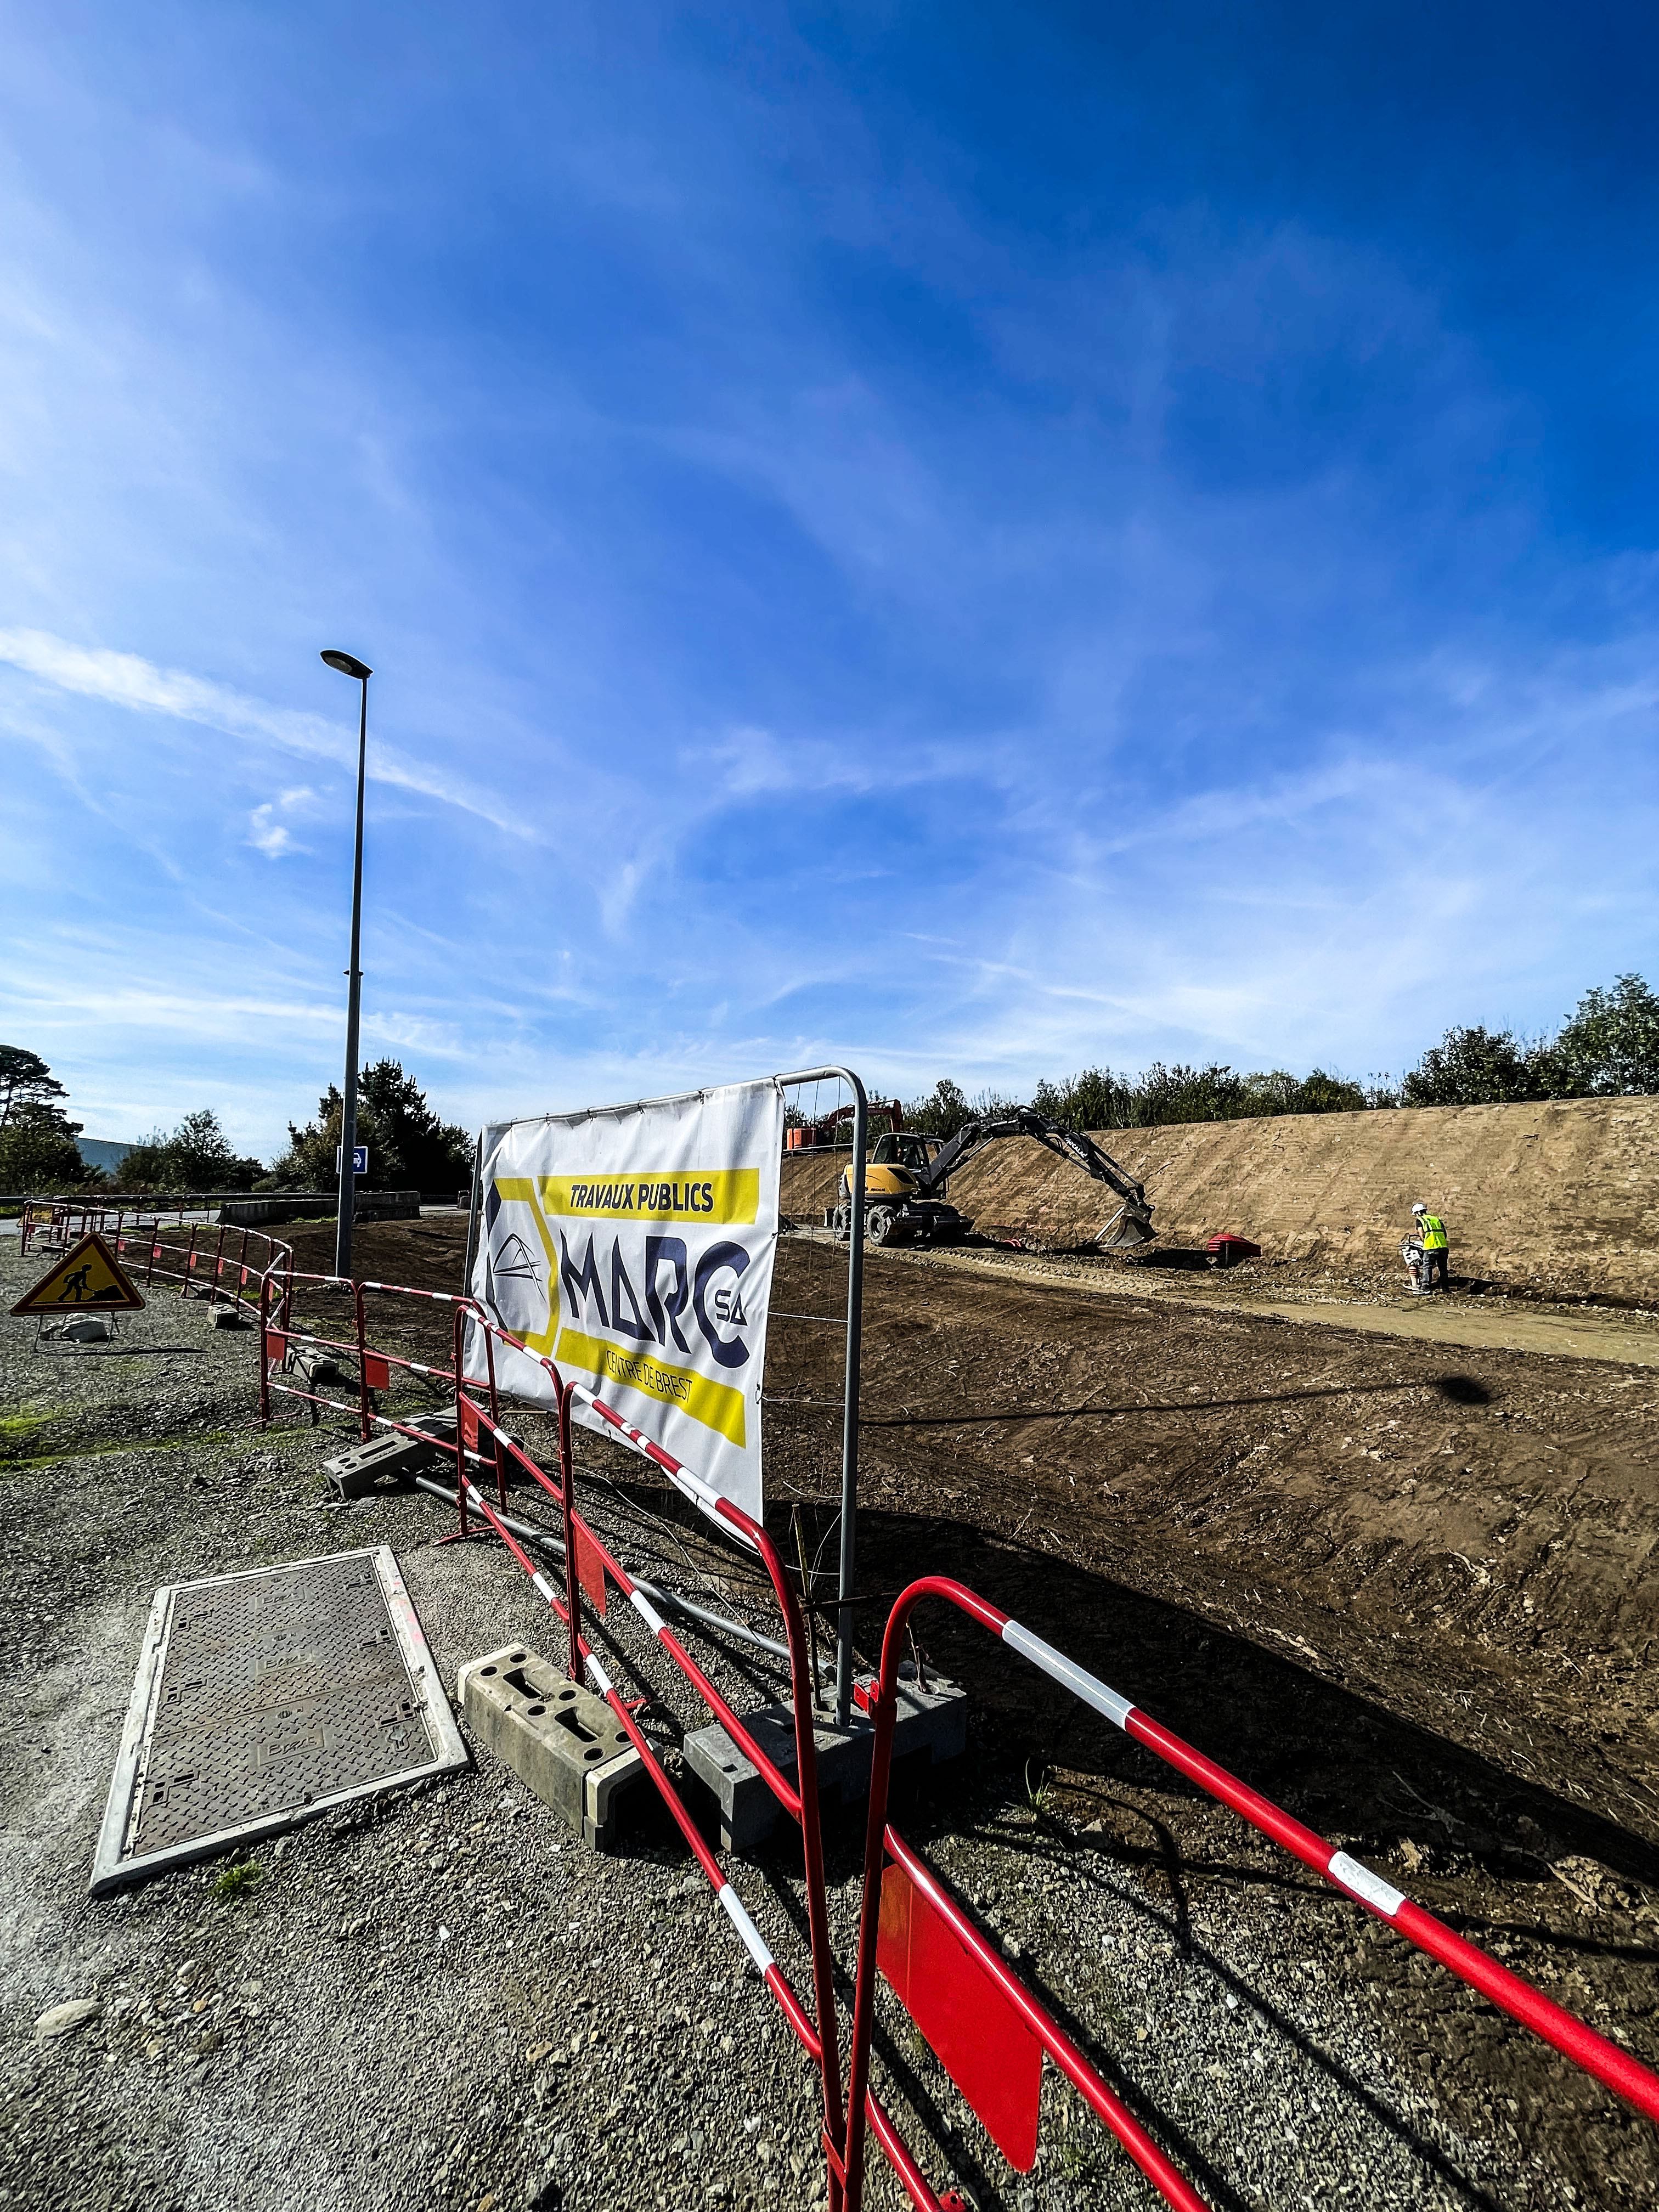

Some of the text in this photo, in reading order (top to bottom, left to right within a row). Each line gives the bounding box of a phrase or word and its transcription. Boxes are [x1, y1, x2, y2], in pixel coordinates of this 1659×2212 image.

[570, 1183, 714, 1213] TRAVAUX PUBLICS
[560, 1228, 751, 1369] MARC
[715, 1289, 748, 1327] SA
[607, 1350, 693, 1403] CENTRE DE BREST
